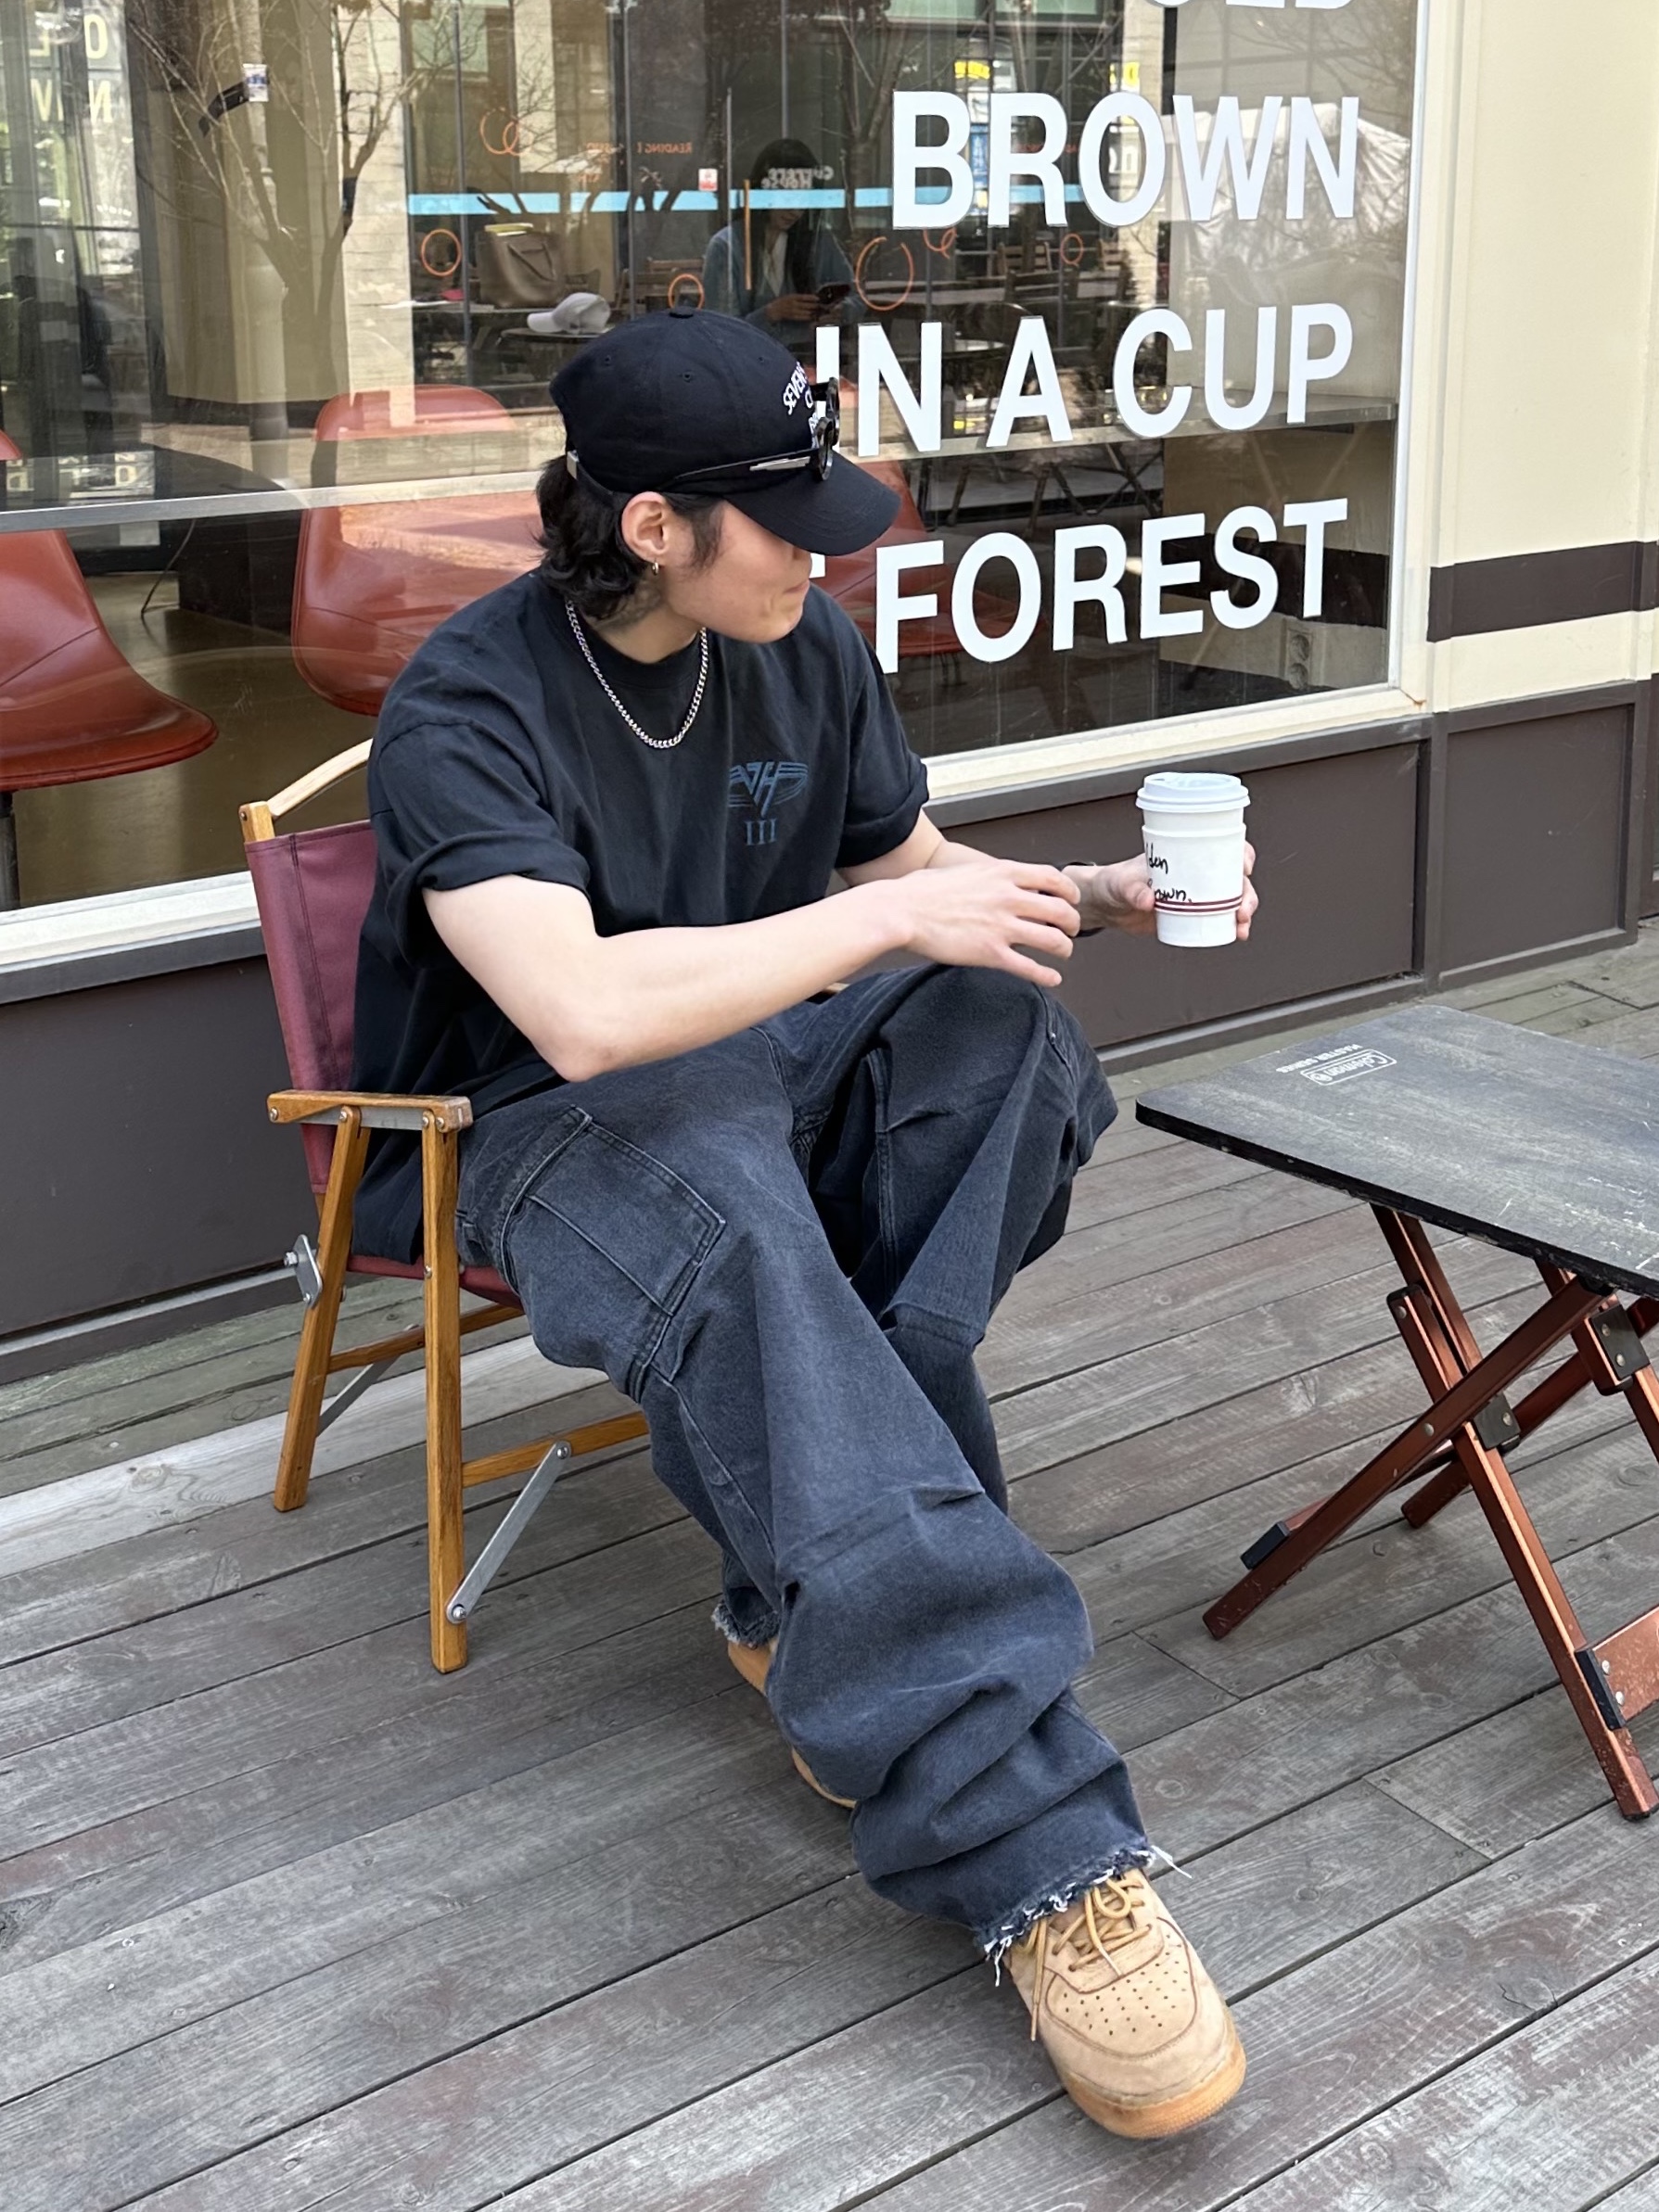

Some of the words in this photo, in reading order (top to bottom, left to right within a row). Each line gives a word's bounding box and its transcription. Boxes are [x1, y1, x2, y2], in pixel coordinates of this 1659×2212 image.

[892, 91, 1359, 228] BROWN
[816, 322, 942, 457] IN
[986, 316, 1073, 448] A
[1114, 303, 1353, 439] CUP
[875, 498, 1347, 674] FOREST
[1322, 1054, 1388, 1077] Coleman
